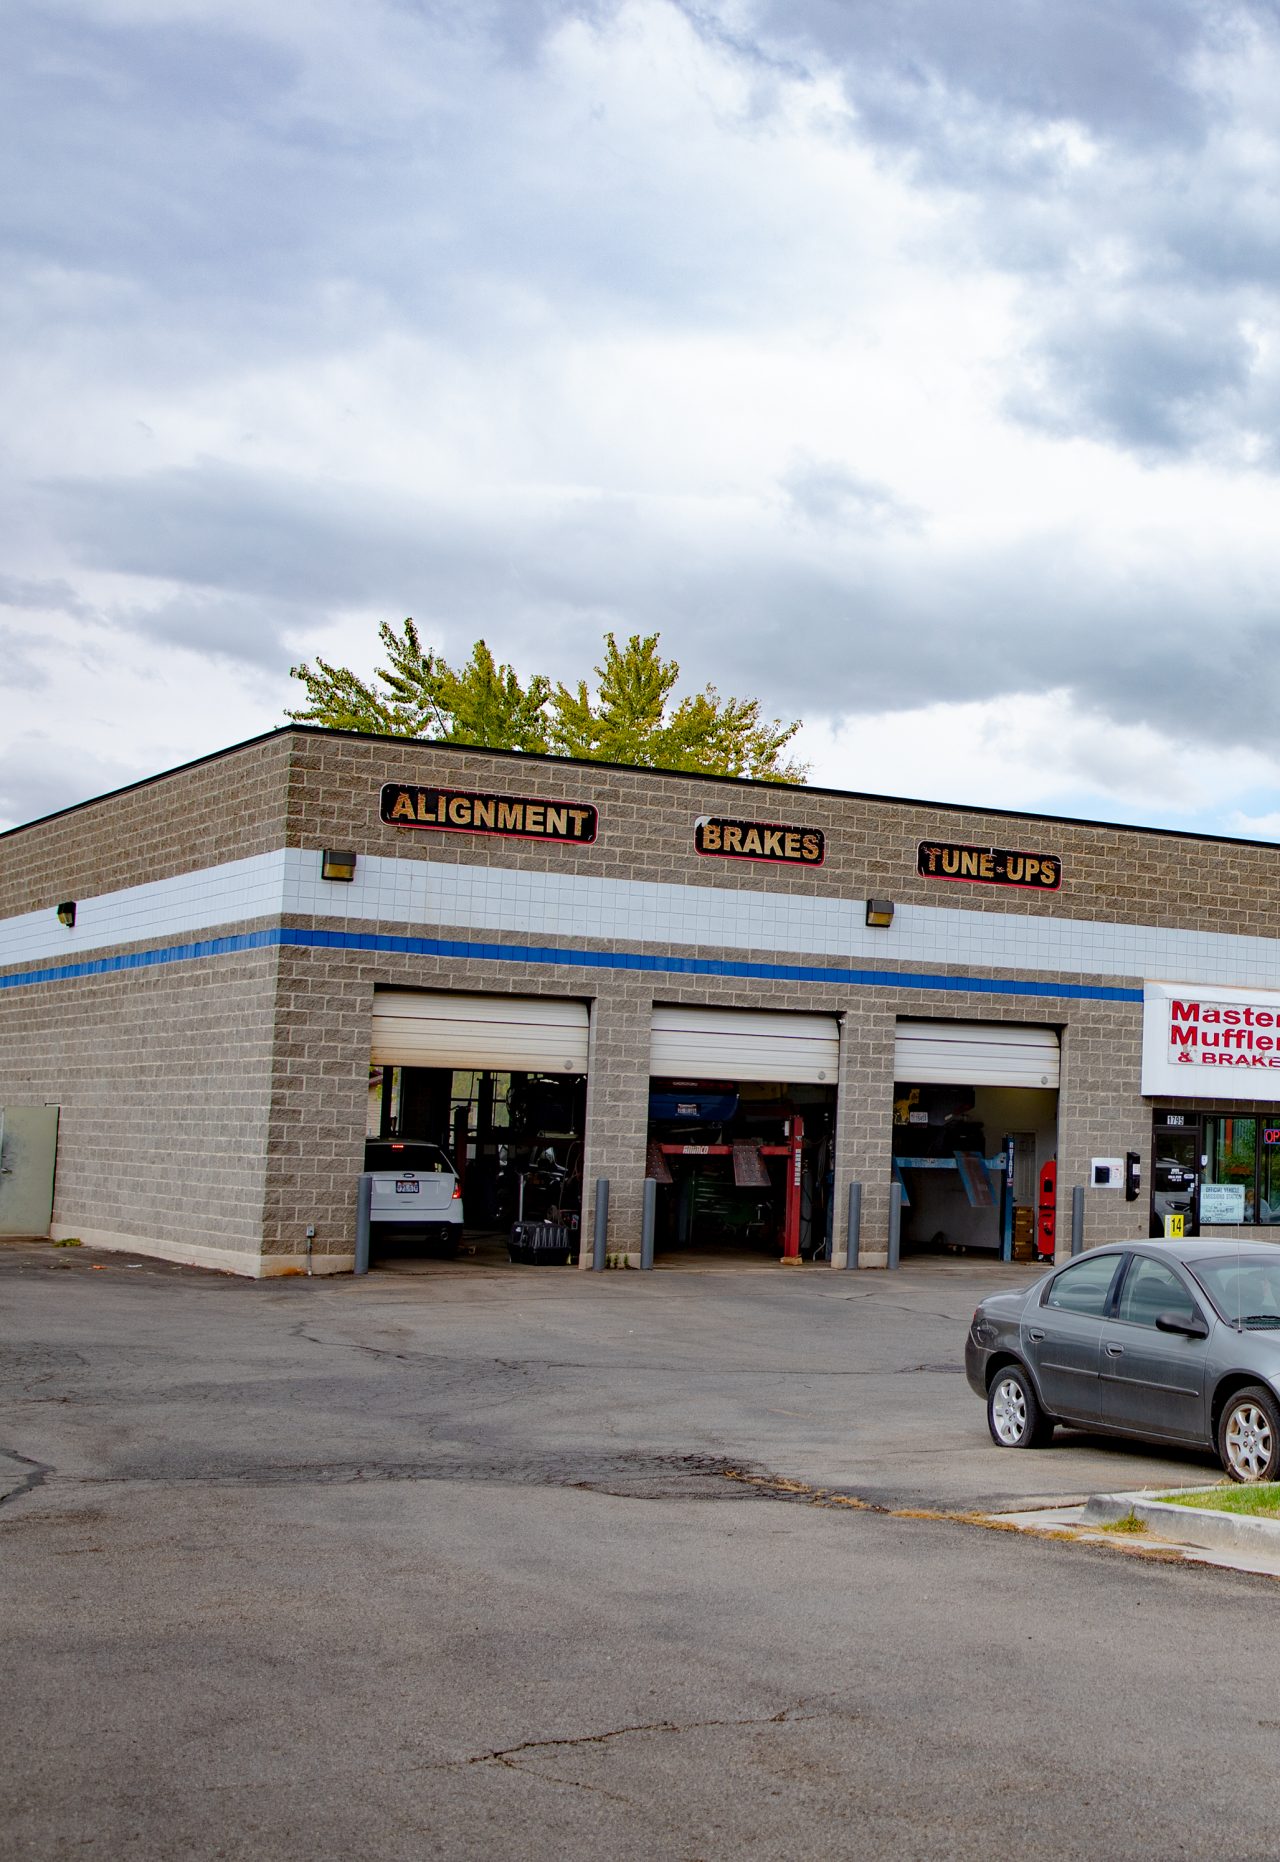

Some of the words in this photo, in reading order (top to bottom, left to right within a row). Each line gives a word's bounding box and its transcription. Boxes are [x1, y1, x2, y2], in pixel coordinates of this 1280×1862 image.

[391, 791, 590, 838] ALIGNMENT
[702, 823, 820, 861] BRAKES
[926, 846, 1056, 885] TUNE-UPS
[1177, 1052, 1194, 1064] &
[1166, 1115, 1184, 1126] 1795
[1171, 1217, 1182, 1233] 14
